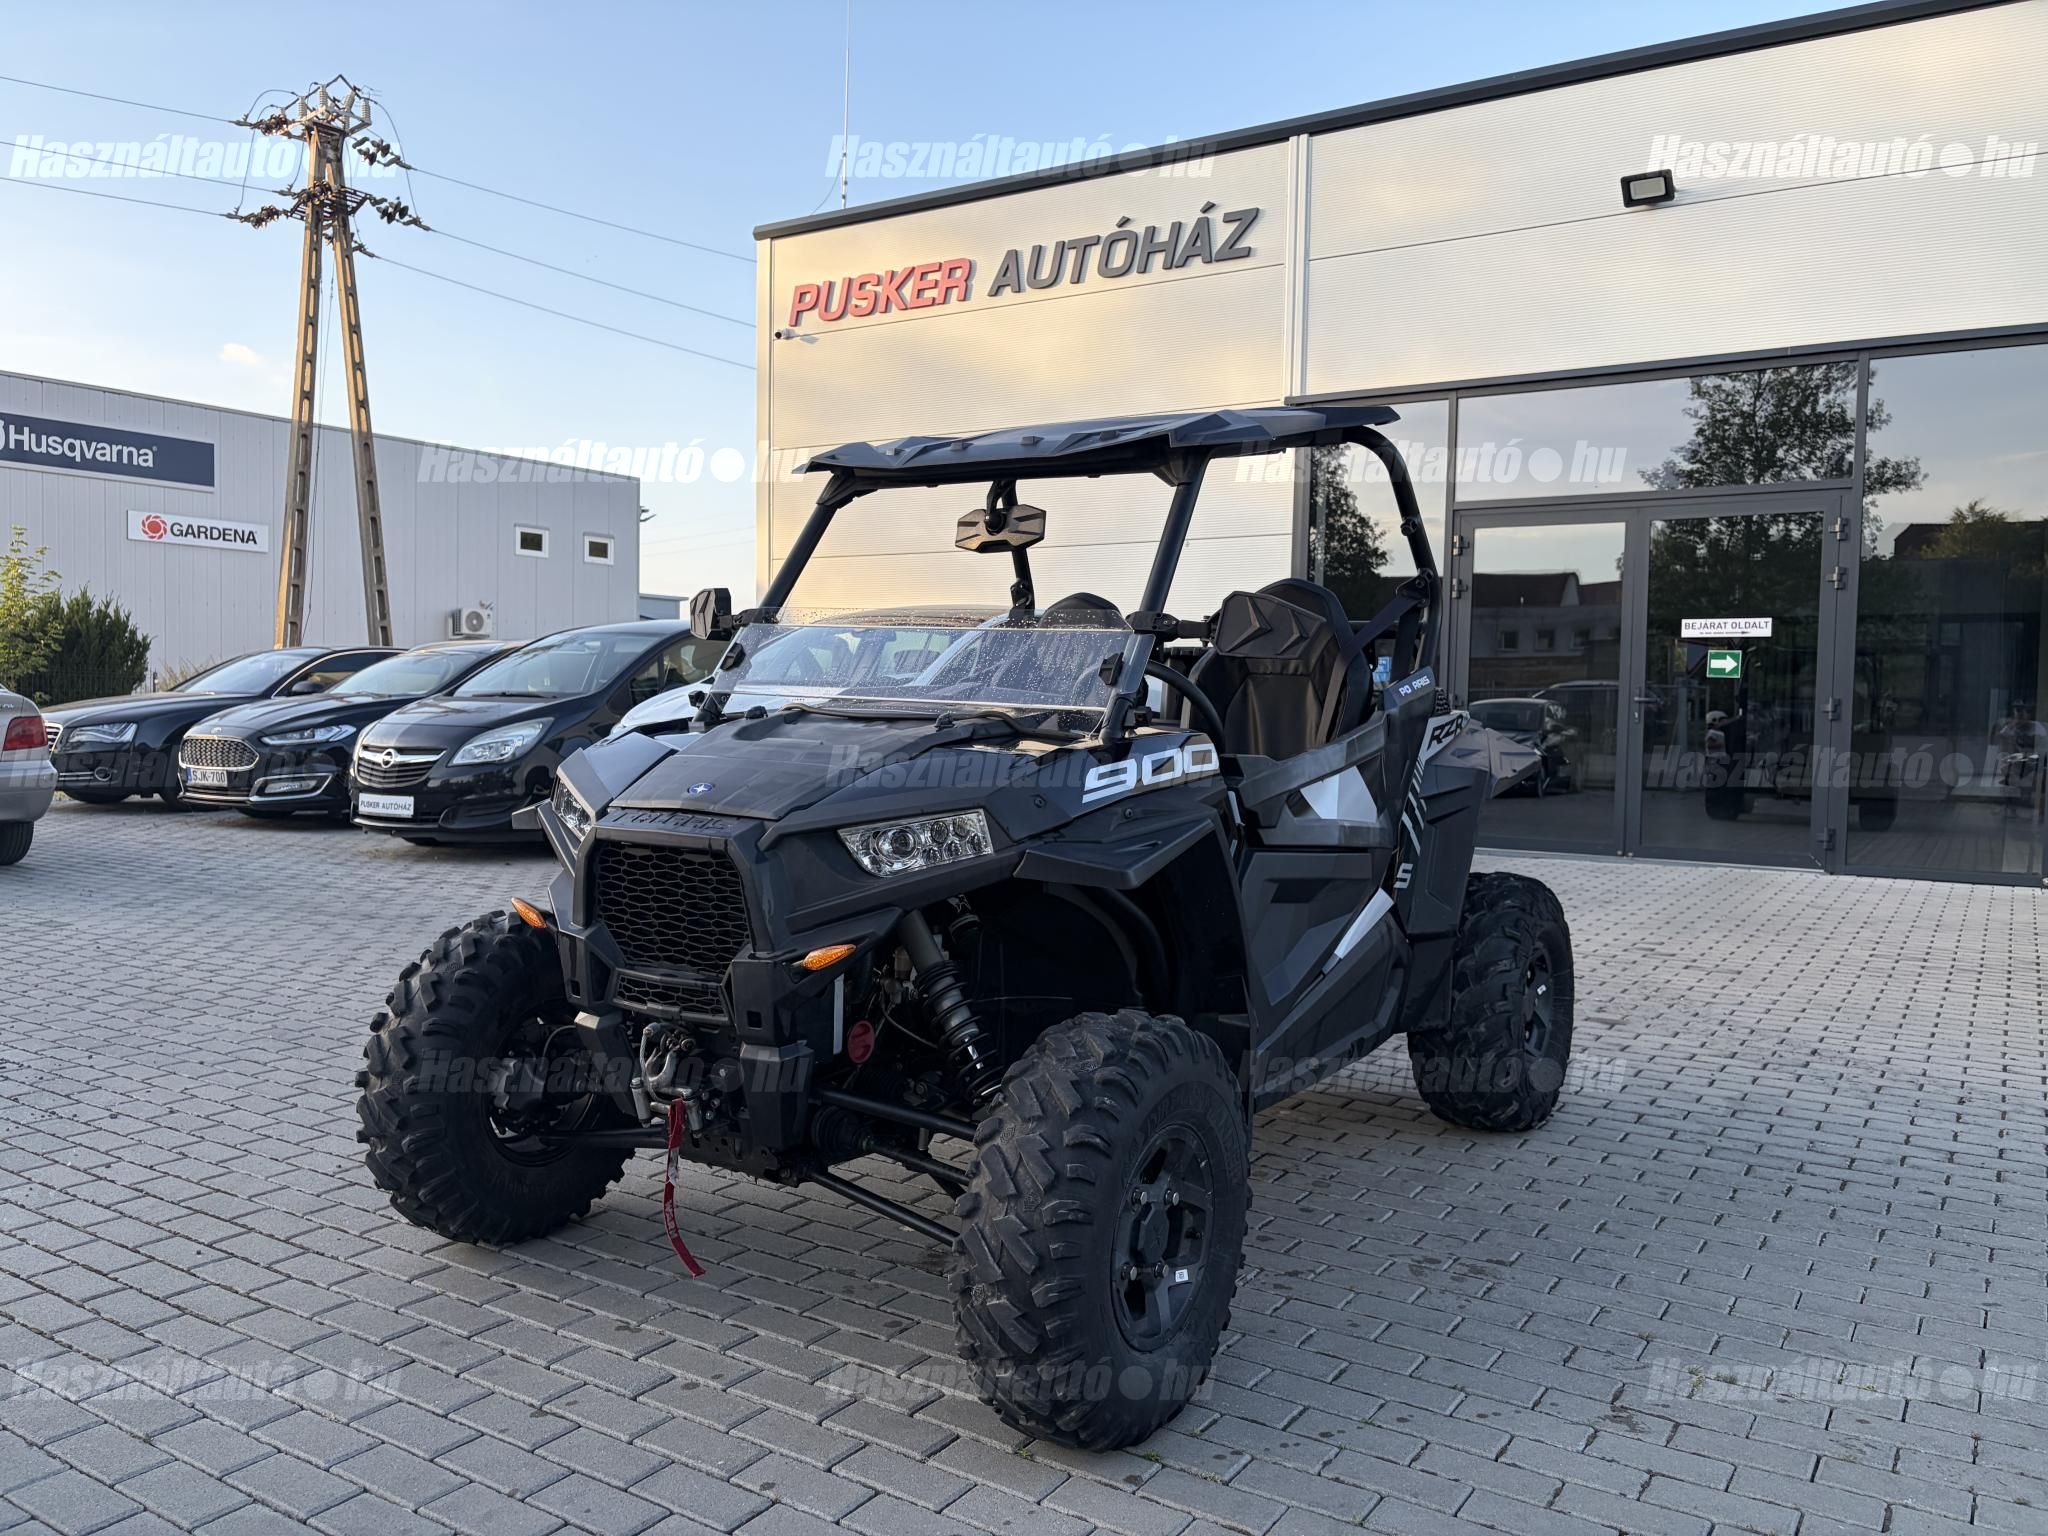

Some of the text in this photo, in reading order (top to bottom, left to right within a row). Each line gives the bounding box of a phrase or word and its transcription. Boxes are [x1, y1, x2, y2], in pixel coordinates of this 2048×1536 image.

[788, 200, 1260, 327] PUSKER AUTÓHÁZ
[8, 424, 154, 468] Husqvarna
[170, 522, 258, 545] GARDENA
[1730, 620, 1770, 630] OLDALT
[1398, 675, 1431, 697] POARIS
[1426, 713, 1464, 752] RZR
[192, 770, 227, 783] SJK-700
[1082, 743, 1220, 804] 900
[360, 800, 412, 811] PUSKER AUTÓHÁZ
